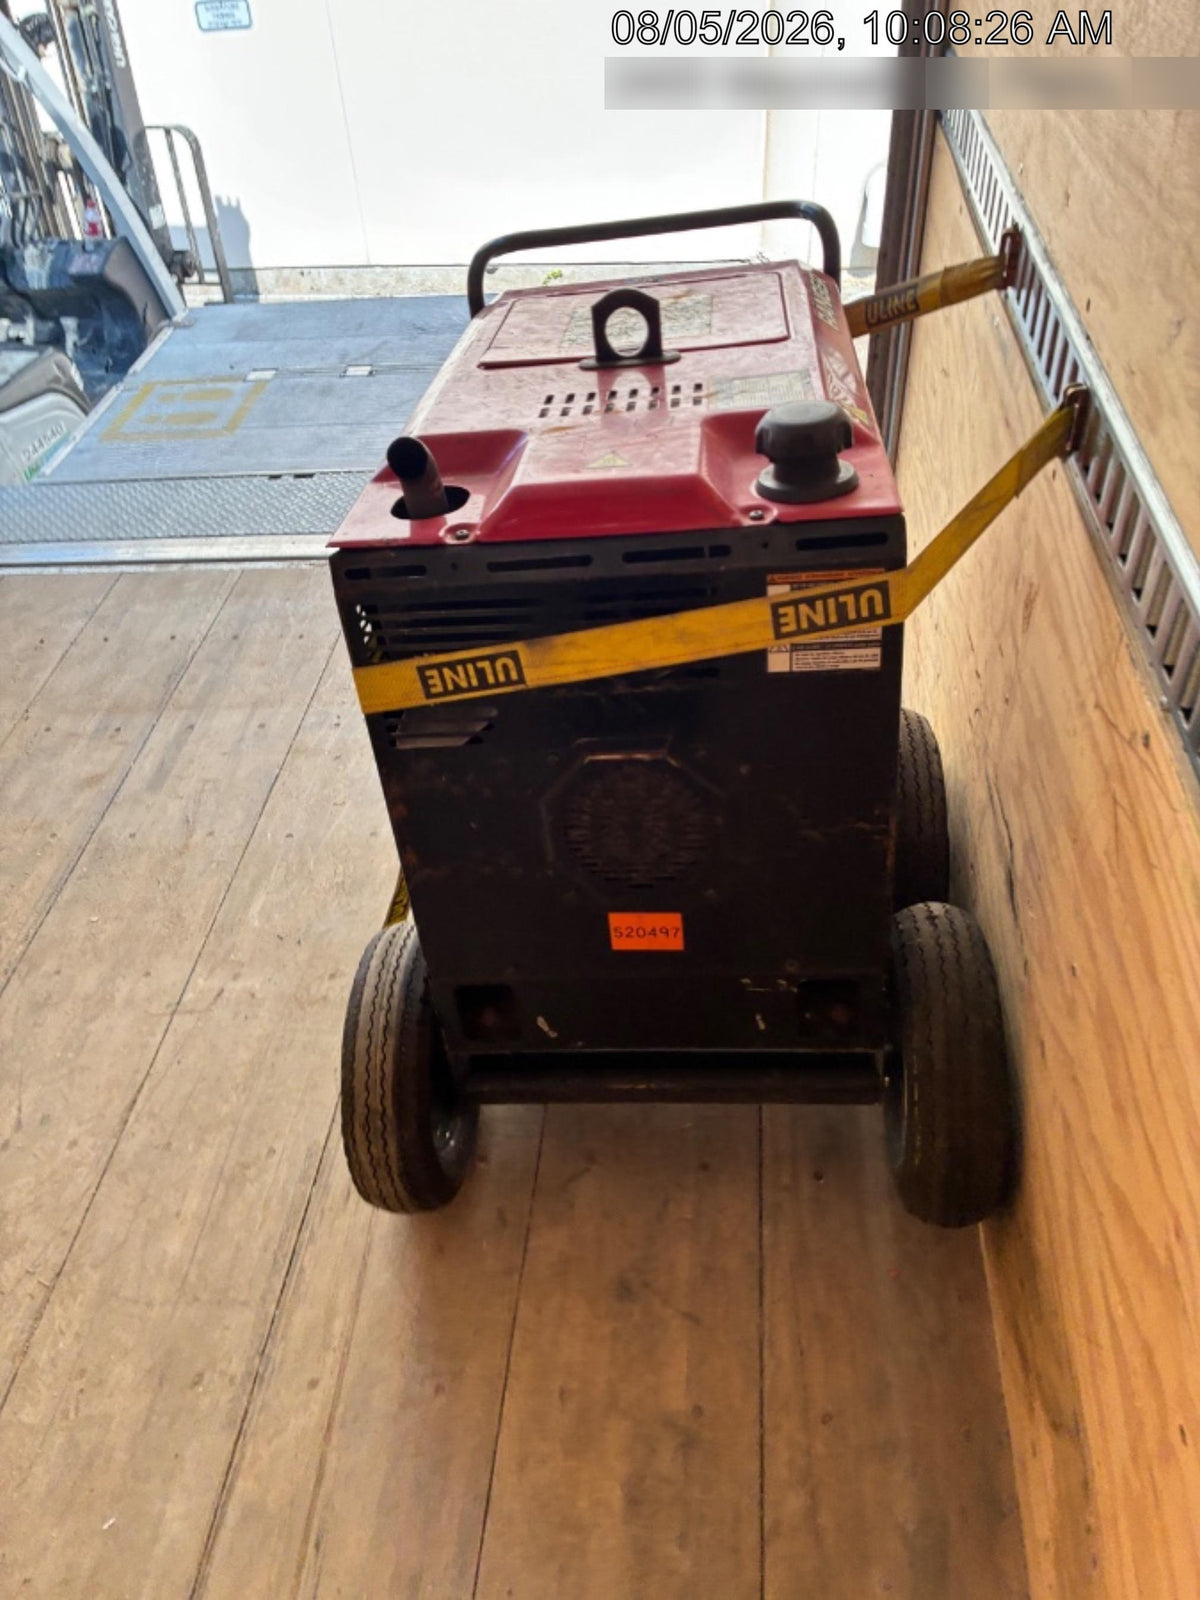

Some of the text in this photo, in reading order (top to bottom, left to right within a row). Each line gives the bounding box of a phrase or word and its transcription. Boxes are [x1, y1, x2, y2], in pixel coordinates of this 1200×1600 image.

[867, 290, 916, 323] ULINE
[777, 588, 884, 634] ULINE
[424, 656, 519, 695] ULINE
[613, 925, 680, 939] 520497
